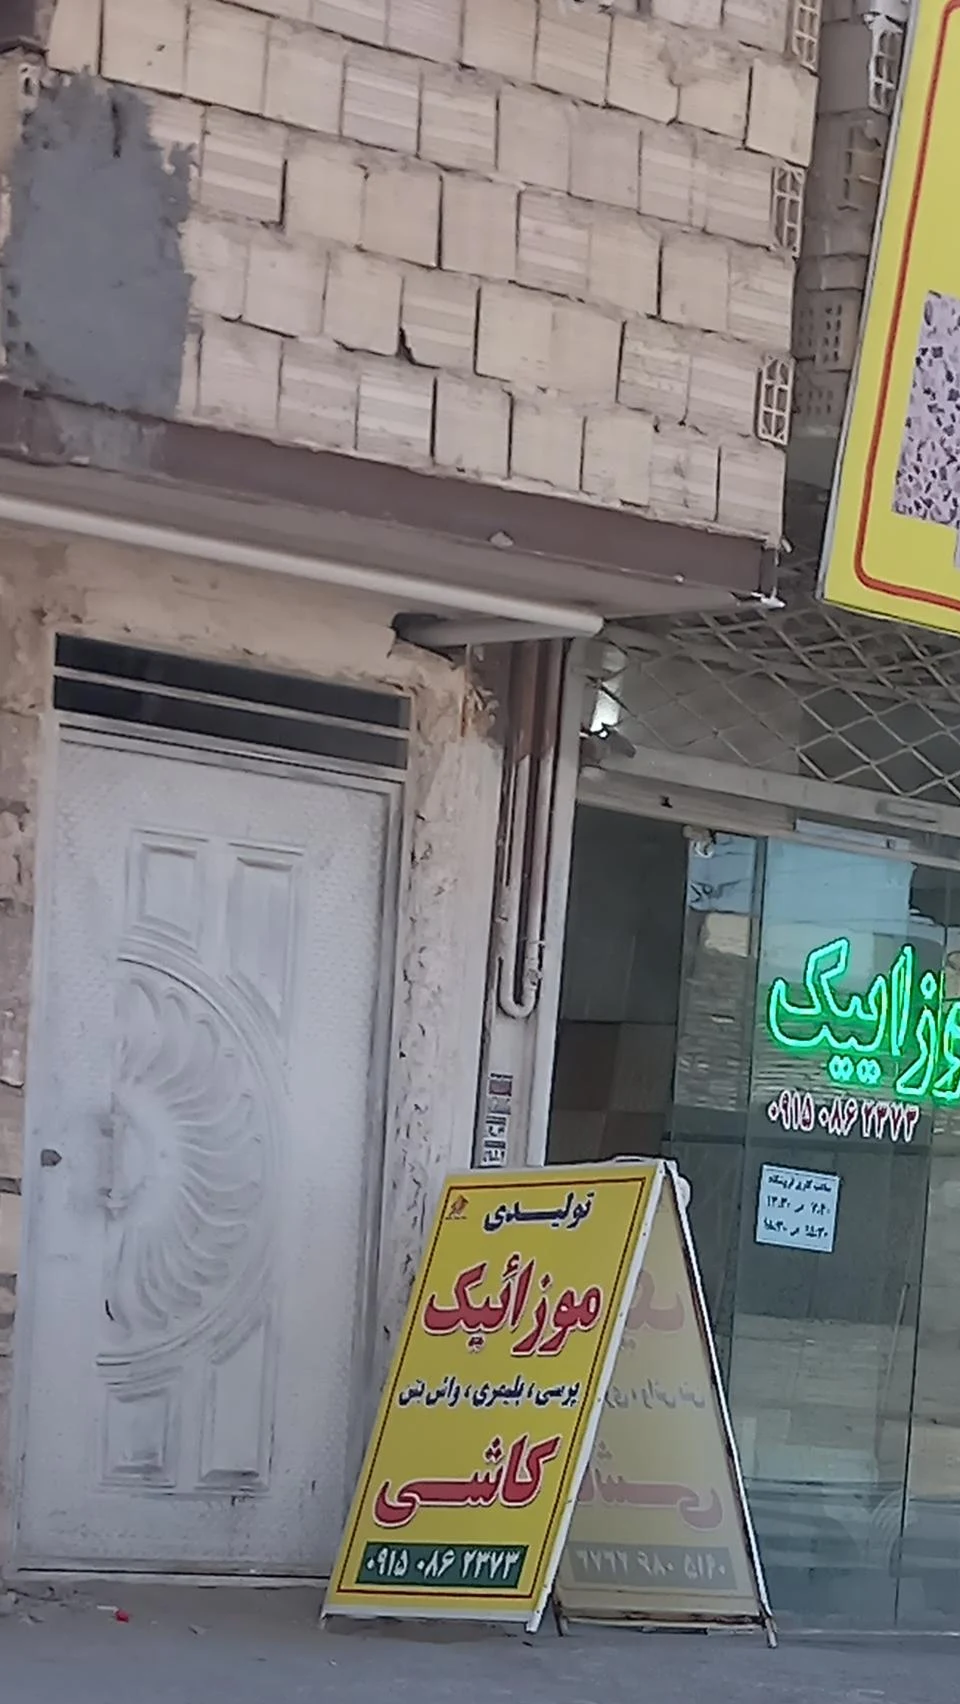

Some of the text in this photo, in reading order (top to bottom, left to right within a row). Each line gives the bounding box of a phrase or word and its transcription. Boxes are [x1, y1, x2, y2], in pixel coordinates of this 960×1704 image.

[768, 1090, 920, 1143] ۰۹۱۵ ۰۸۶ ۲۳۷۳
[484, 1192, 595, 1231] تولیدی
[423, 1252, 604, 1358] موزائیک
[373, 1434, 563, 1530] کاشی
[367, 1547, 520, 1579] ۰۹۱۵ ۰۸۶ ۲۳۷۳
